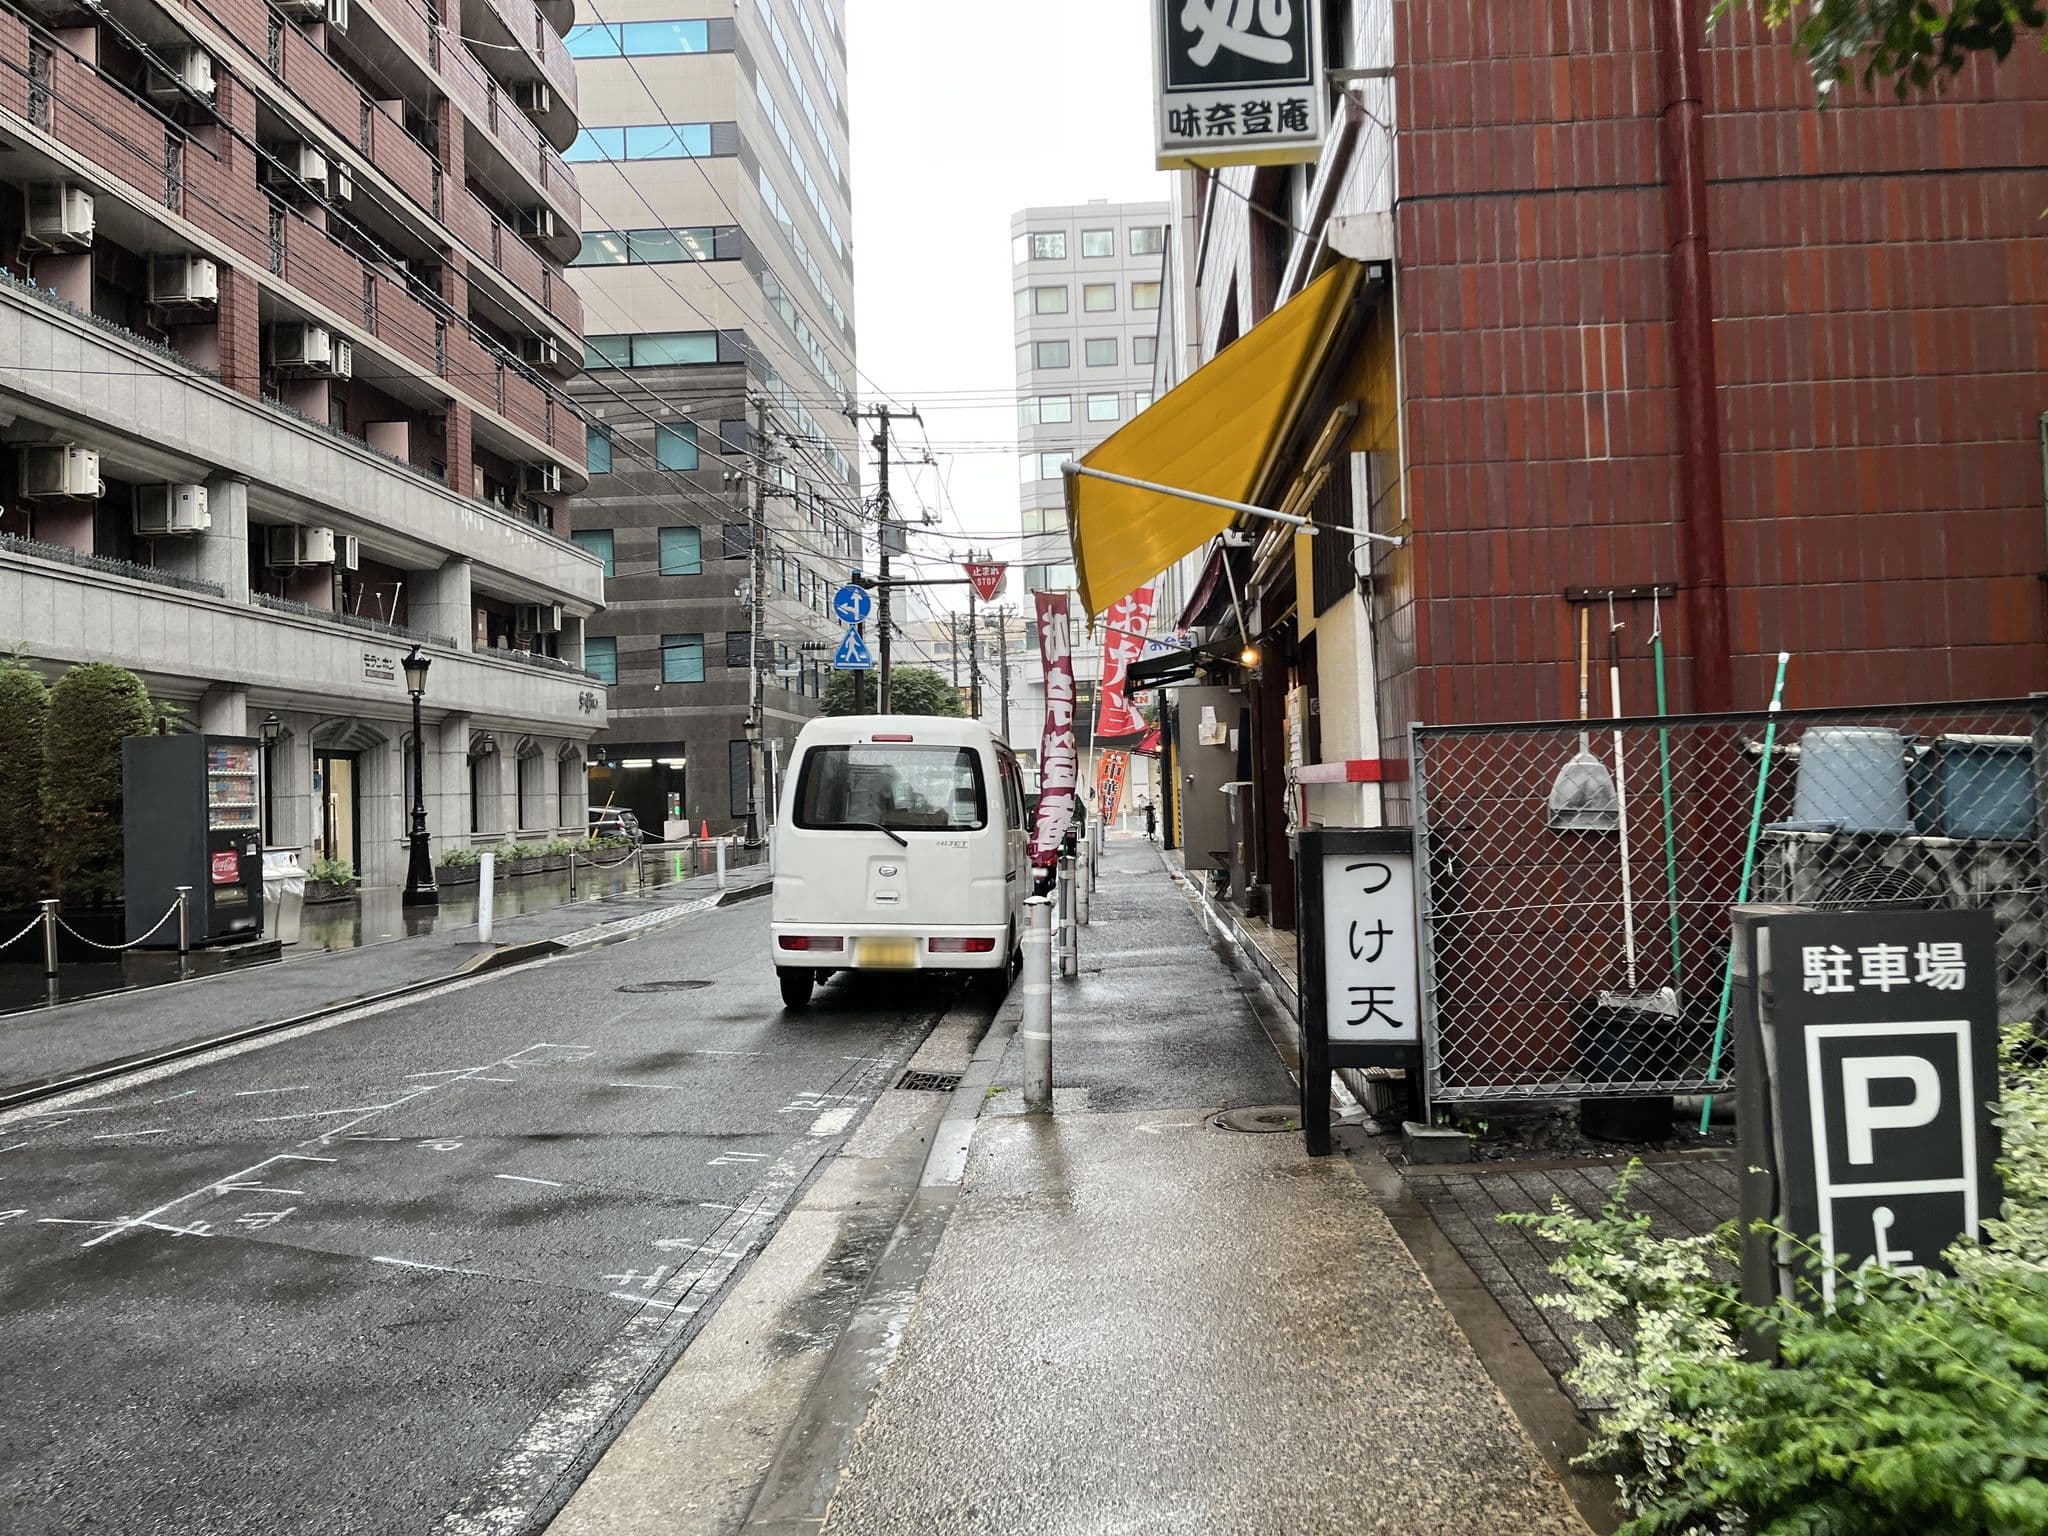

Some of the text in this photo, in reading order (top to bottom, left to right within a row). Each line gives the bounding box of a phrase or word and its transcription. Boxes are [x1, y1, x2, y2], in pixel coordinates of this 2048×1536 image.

[1167, 98, 1309, 138] 味奈登庵
[973, 566, 999, 576] 止まれ
[976, 577, 997, 586] STOP
[1345, 862, 1403, 1028] つけ天
[1802, 942, 1967, 995] 駐車場
[1841, 1055, 1941, 1165] P
